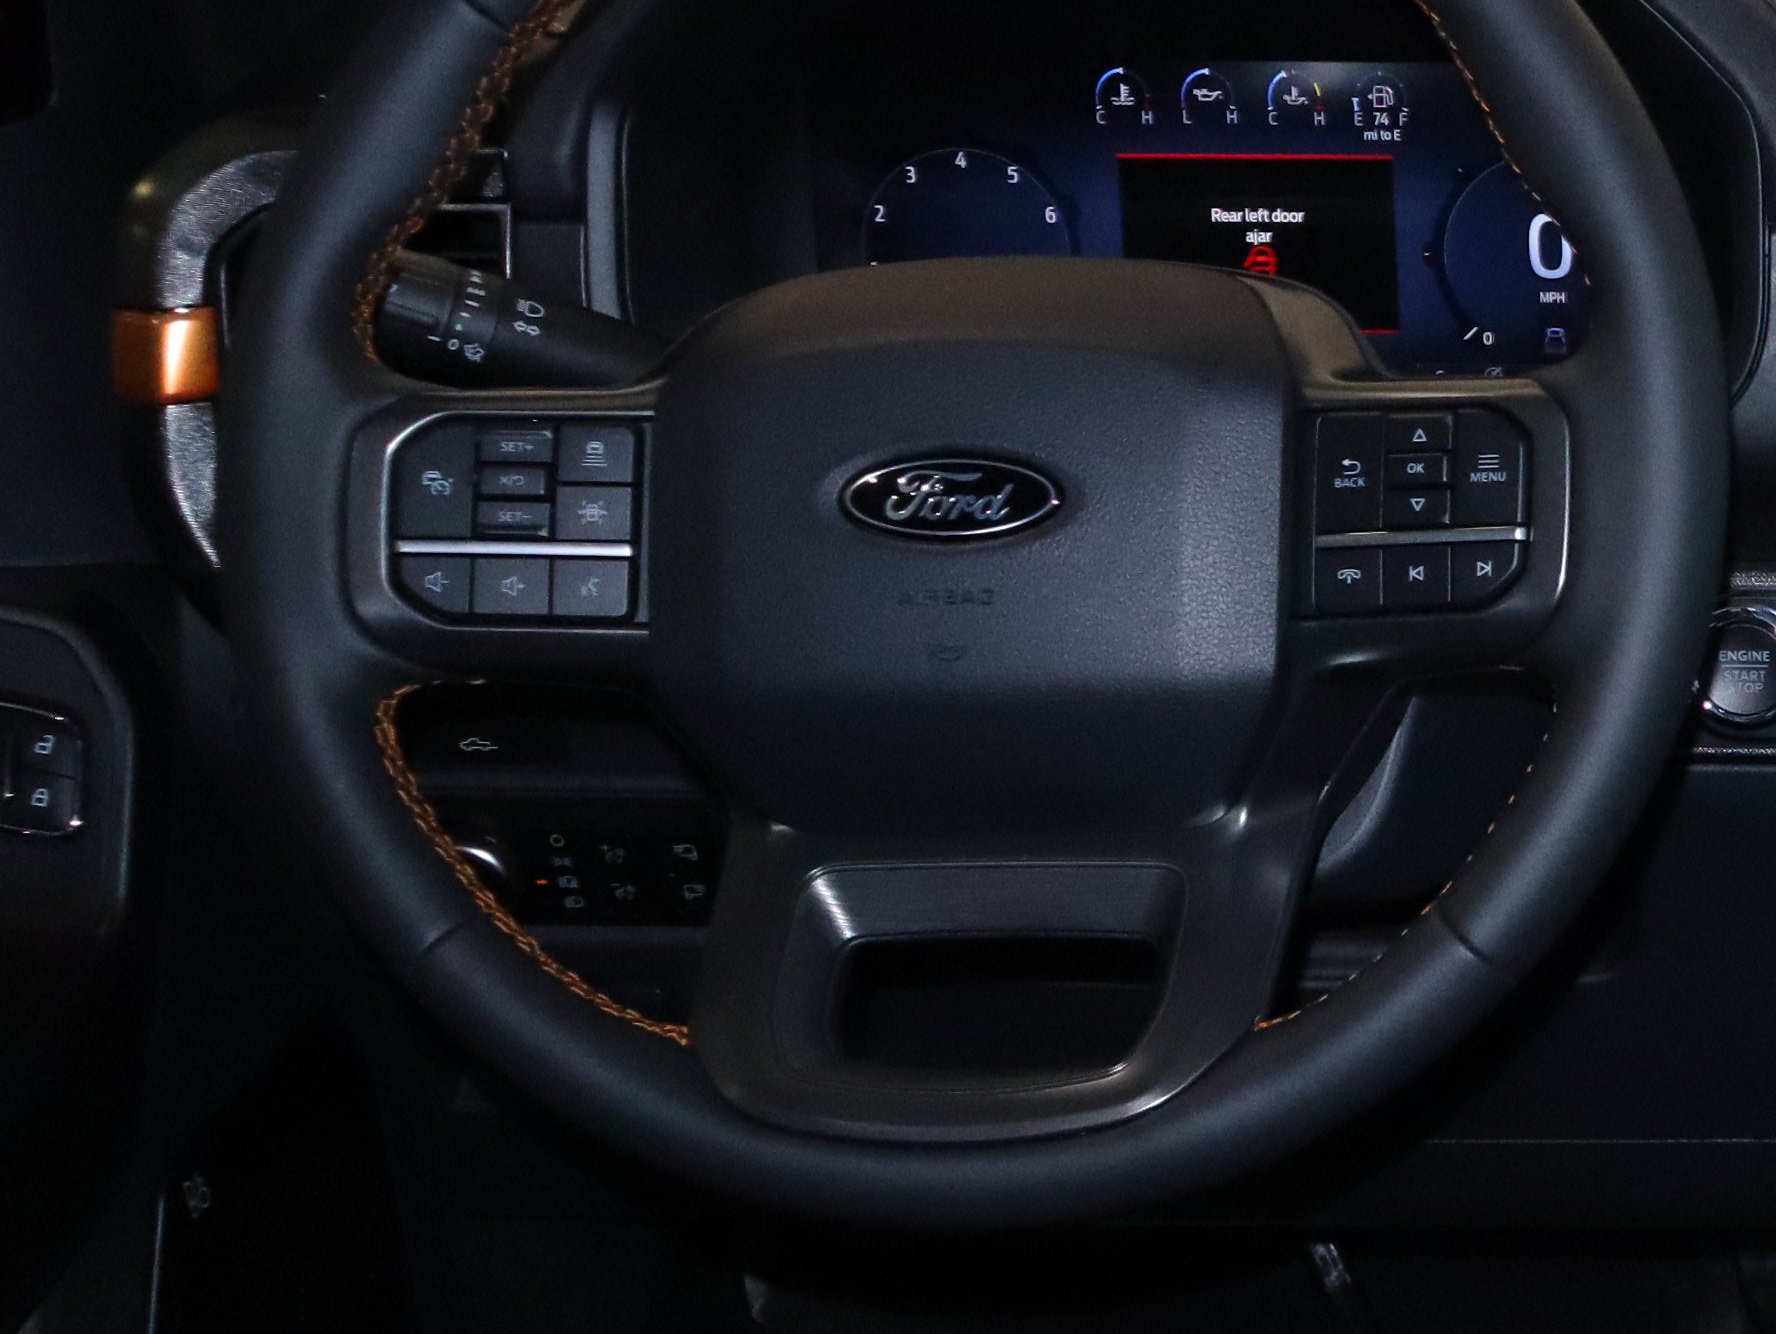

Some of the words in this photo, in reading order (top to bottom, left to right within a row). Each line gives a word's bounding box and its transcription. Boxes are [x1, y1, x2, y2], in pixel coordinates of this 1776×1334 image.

[1096, 111, 1107, 125] C
[1141, 111, 1153, 125] H
[1182, 111, 1192, 125] L
[1227, 111, 1238, 124] H
[1268, 112, 1279, 126] C
[1314, 112, 1325, 126] H
[1354, 113, 1363, 126] E
[1373, 113, 1390, 126] 74
[1364, 130, 1378, 141] mi
[1380, 131, 1392, 141] to
[1394, 131, 1401, 141] E
[955, 151, 967, 168] 4
[905, 166, 917, 183] 3
[1007, 166, 1019, 183] 5
[874, 205, 886, 222] 2
[1045, 206, 1057, 224] 6
[1210, 208, 1243, 222] Rear
[1245, 208, 1270, 222] left
[1271, 208, 1305, 223] door
[1246, 228, 1273, 245] ajar
[1539, 292, 1567, 304] MPH
[1483, 332, 1495, 346] 0
[1406, 463, 1425, 474] OK
[1333, 476, 1366, 488] BACK
[1470, 471, 1507, 482] MENU
[885, 469, 1015, 521] Ford
[1719, 650, 1770, 662] ENGINE
[1724, 670, 1767, 682] START
